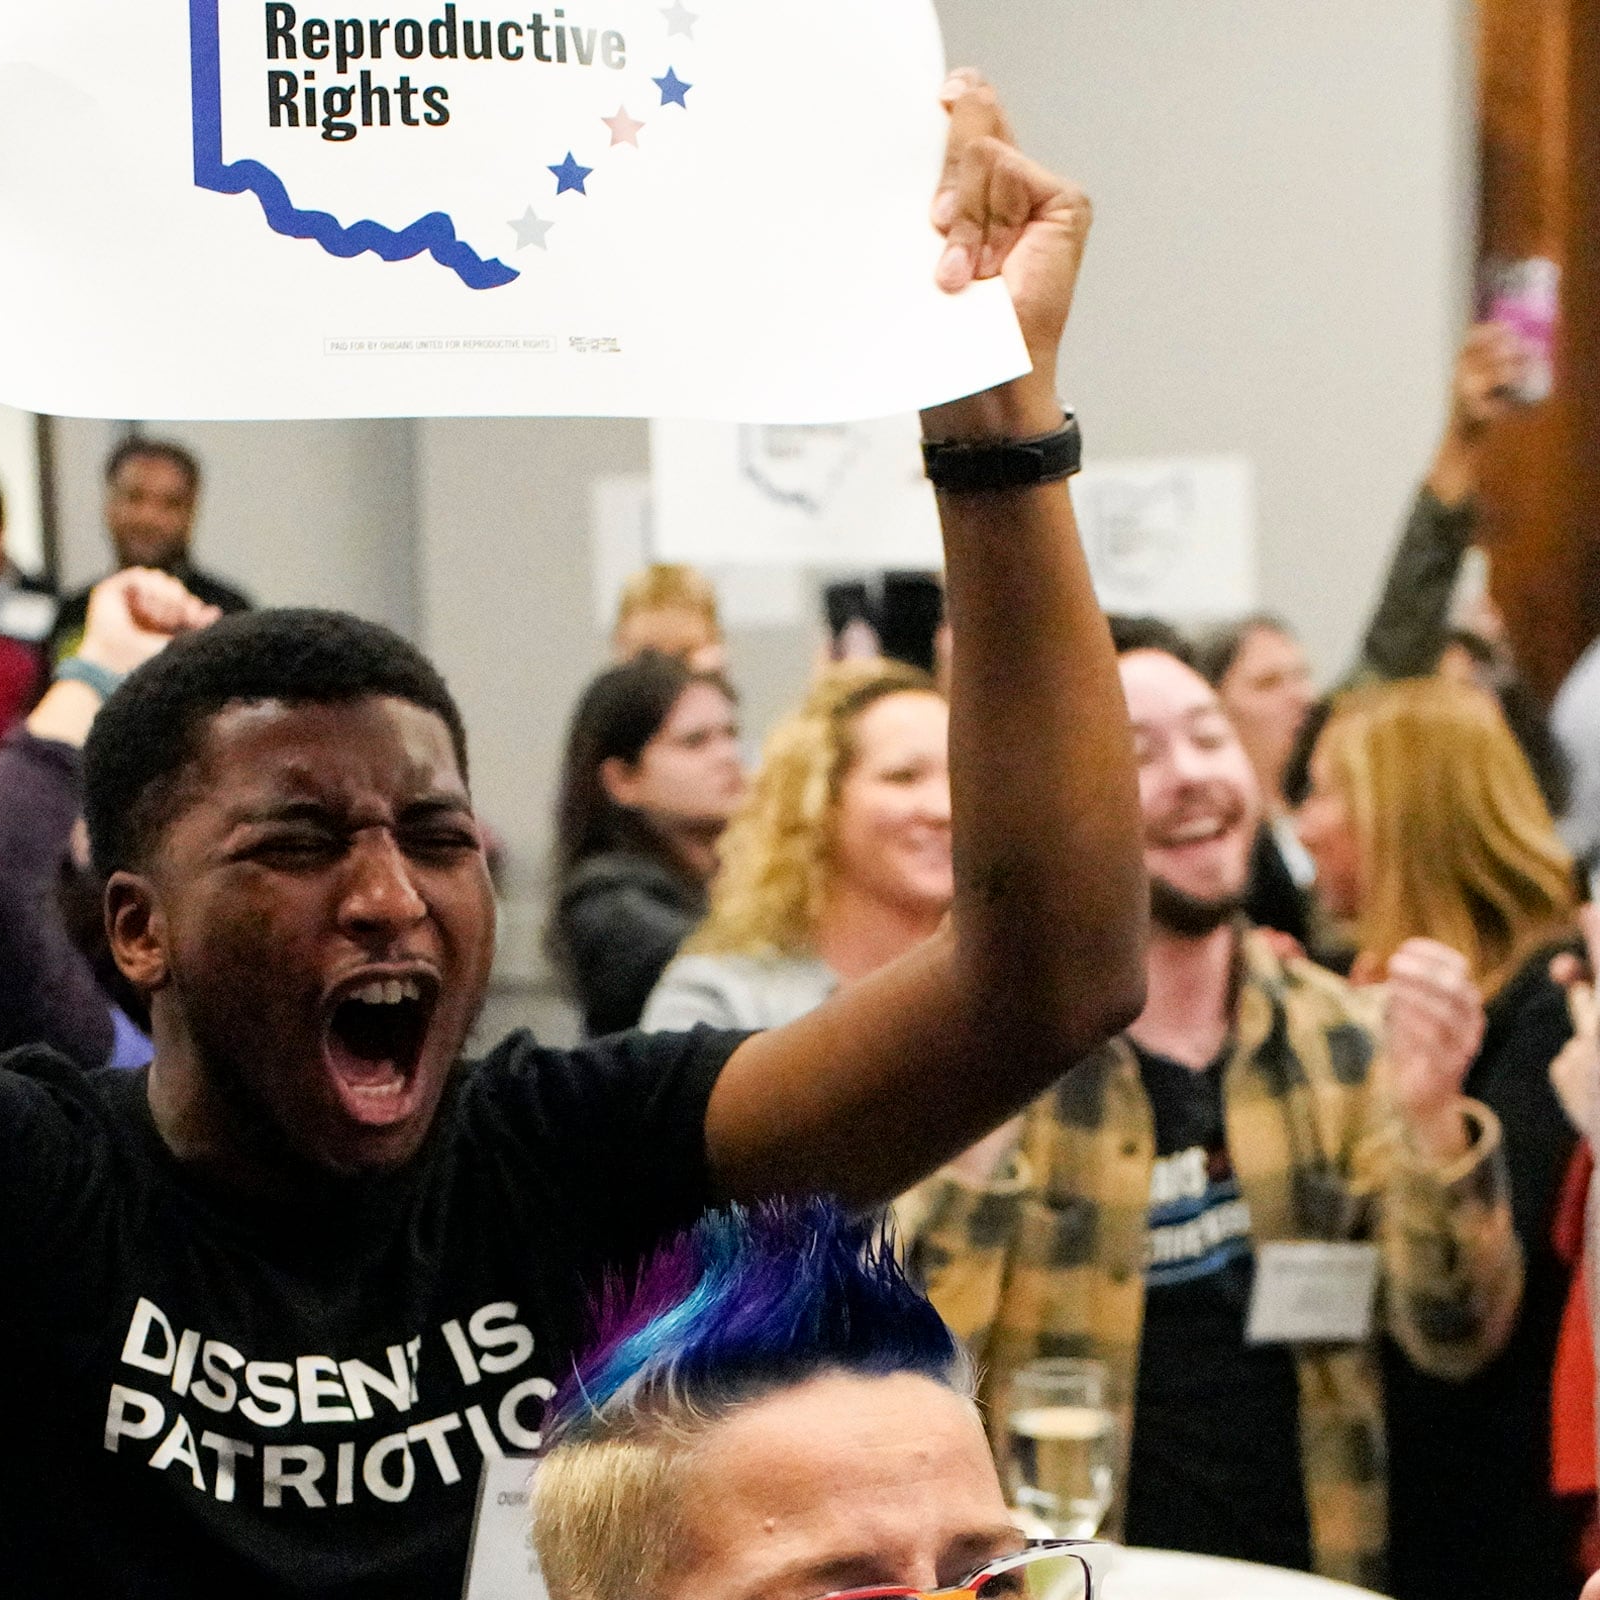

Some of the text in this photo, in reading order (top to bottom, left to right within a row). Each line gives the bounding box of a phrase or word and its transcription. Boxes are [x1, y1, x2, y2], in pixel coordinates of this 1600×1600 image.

[265, 1, 626, 74] Reproductive
[267, 70, 450, 142] Rights
[350, 341, 365, 351] FOR
[445, 340, 460, 349] FOR
[463, 339, 521, 349] REPRODUCTIVE
[523, 339, 551, 349] RIGHTS
[441, 1301, 535, 1386] IS
[104, 1377, 558, 1507] PATRIOTIC
